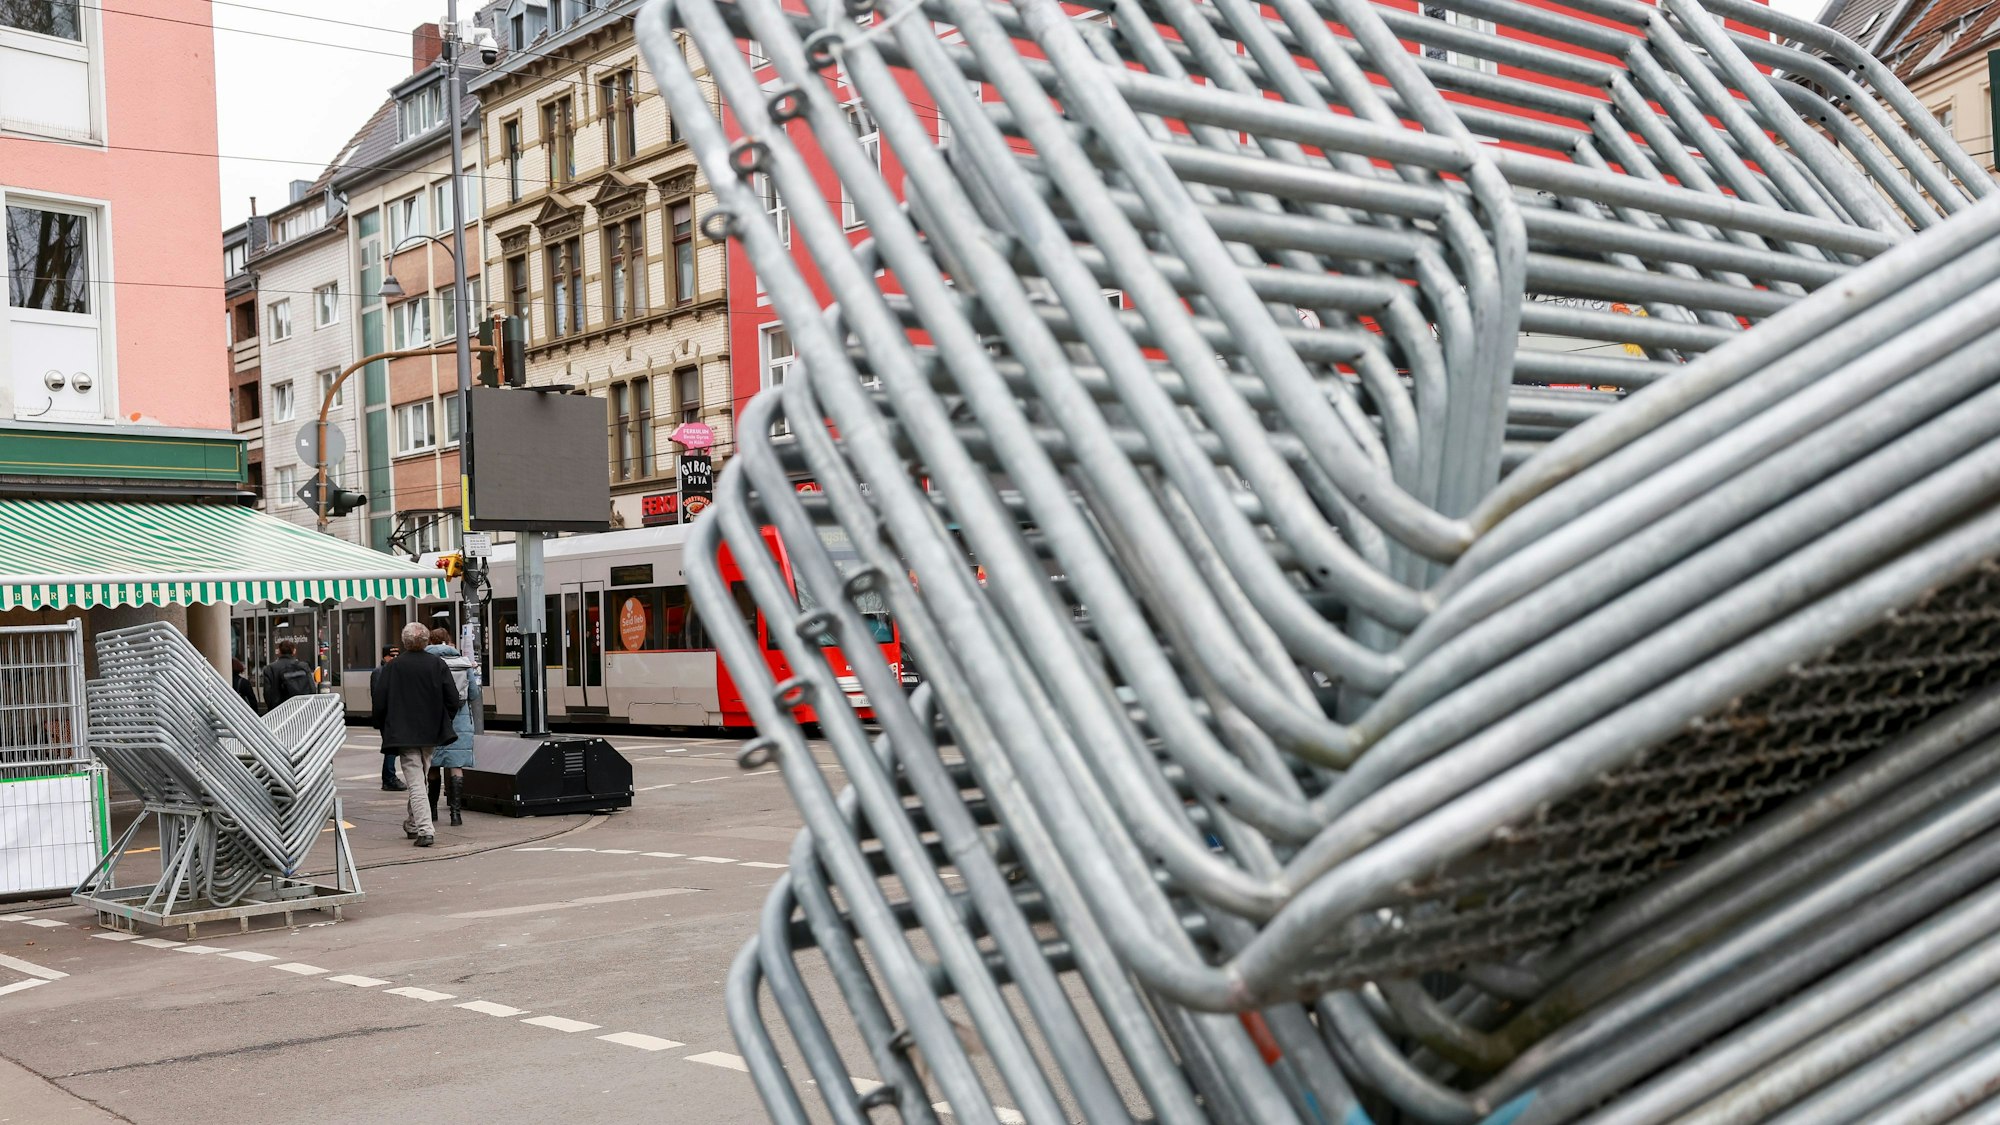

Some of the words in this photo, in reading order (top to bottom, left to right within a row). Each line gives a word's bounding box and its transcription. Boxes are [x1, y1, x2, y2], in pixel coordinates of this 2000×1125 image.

[681, 461, 711, 476] GYROS
[642, 495, 677, 516] FERKU
[14, 592, 58, 601] BAR
[85, 589, 192, 600] KITCHEN
[506, 651, 516, 659] nett
